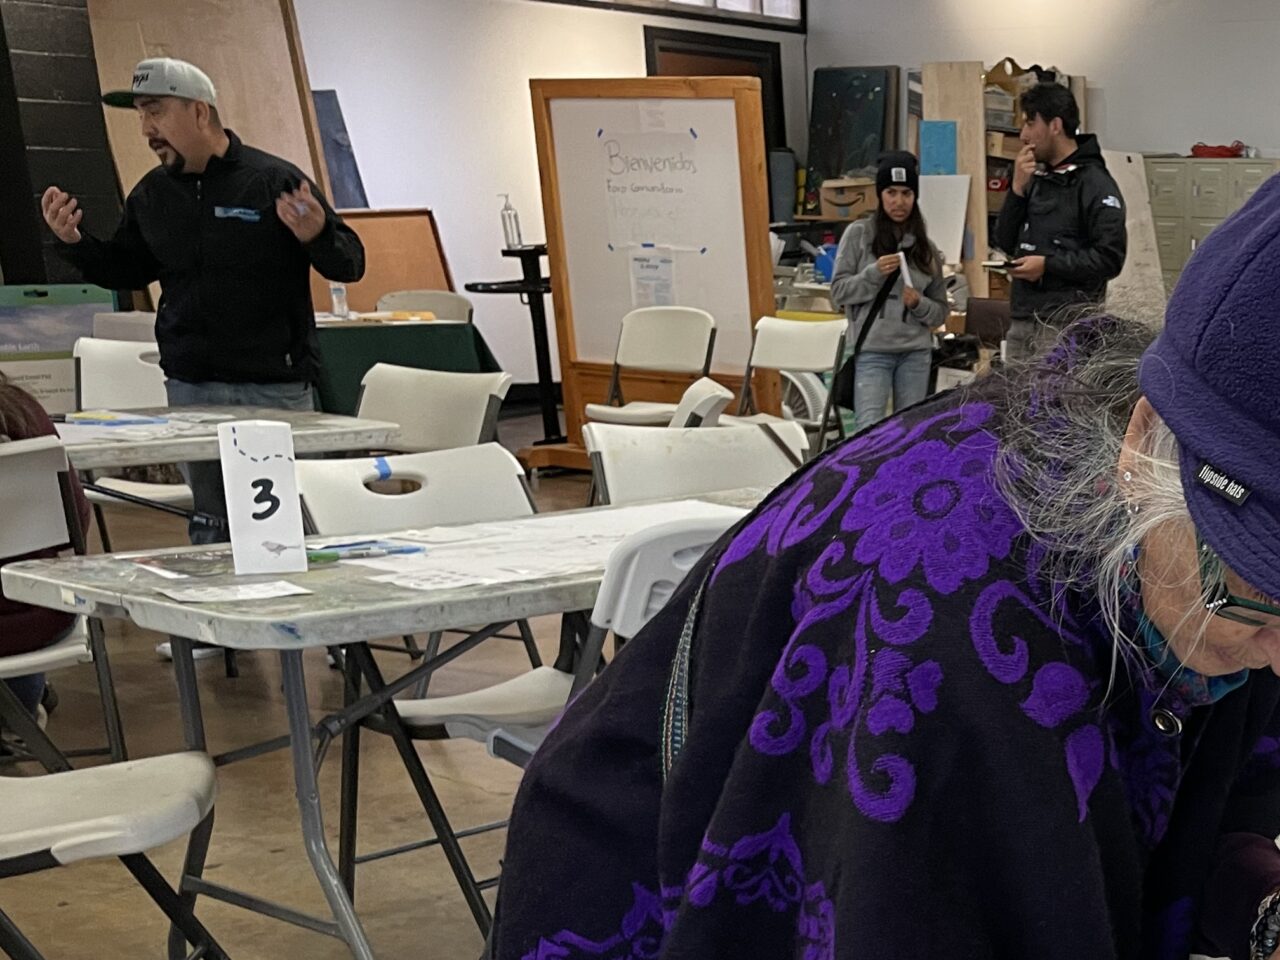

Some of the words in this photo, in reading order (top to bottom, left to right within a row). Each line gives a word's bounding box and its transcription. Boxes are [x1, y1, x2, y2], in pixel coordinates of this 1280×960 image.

[604, 139, 697, 175] Bienvenidos
[250, 478, 281, 521] 3
[1198, 464, 1228, 490] flipside
[1225, 479, 1245, 499] hats
